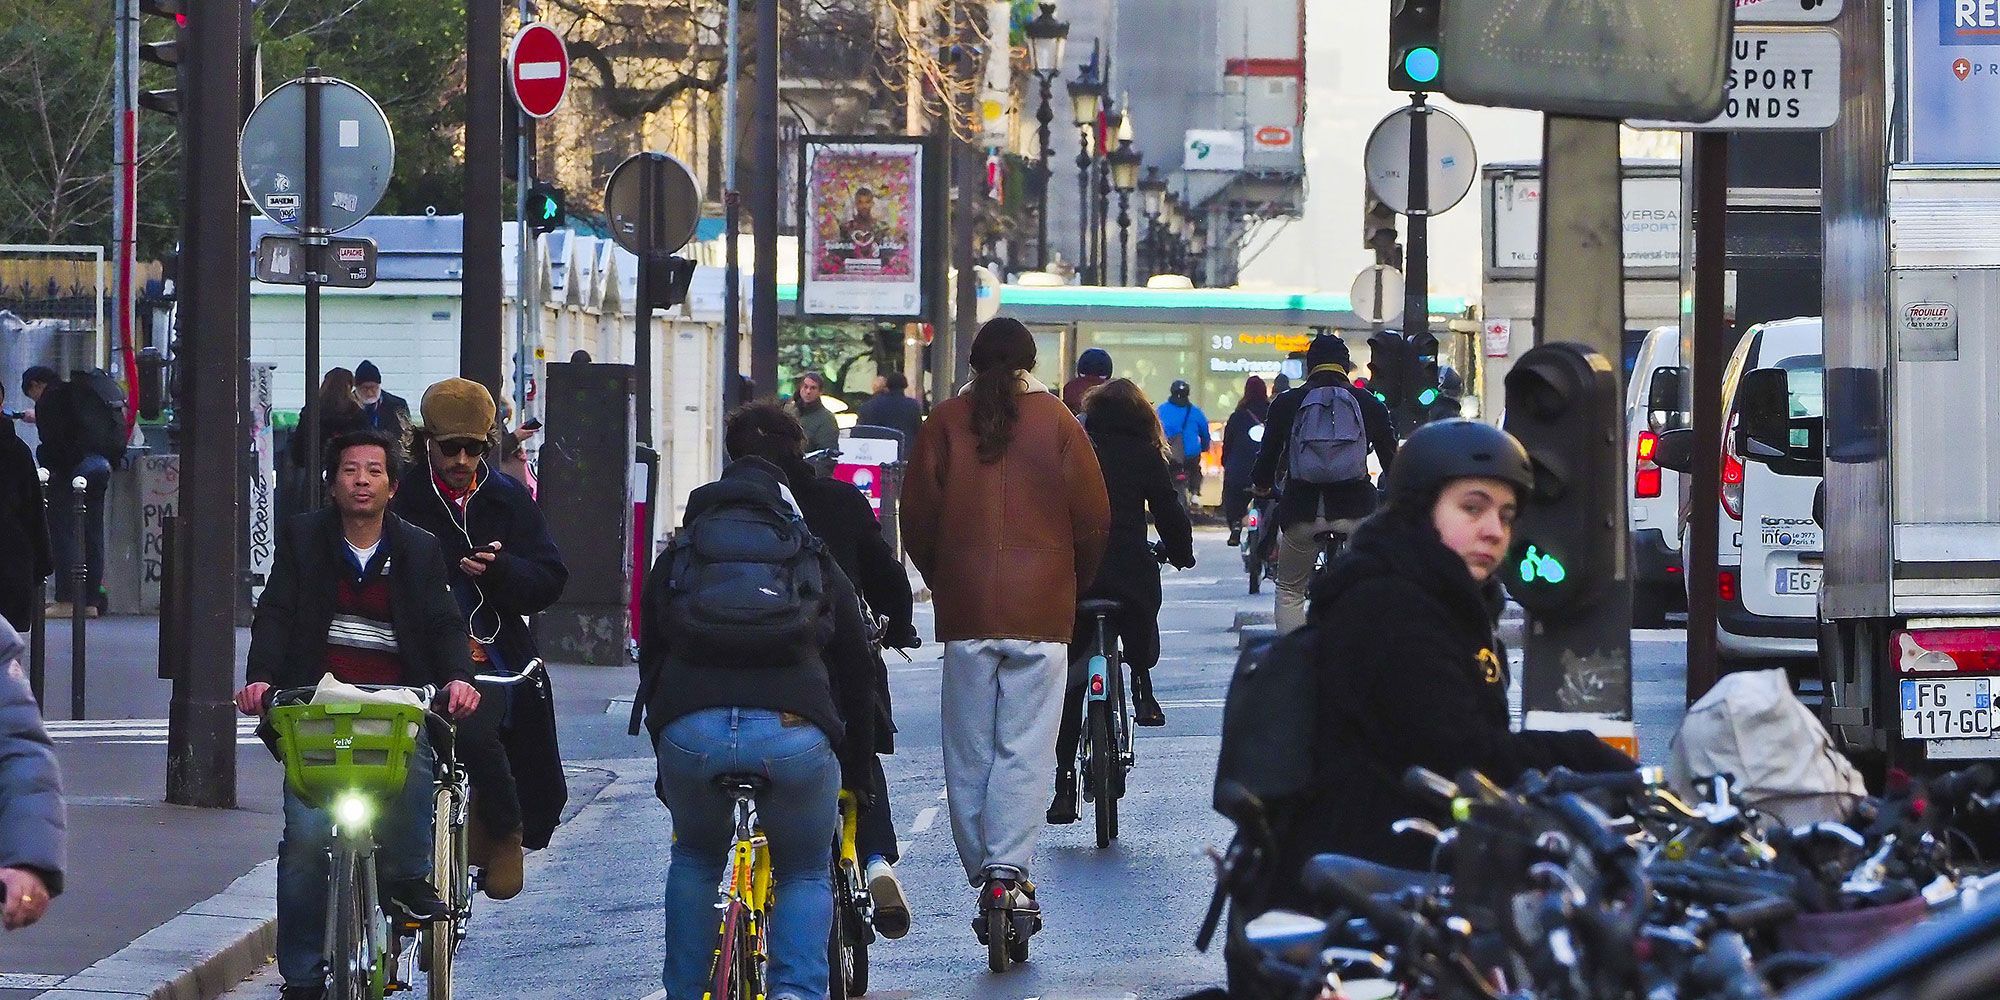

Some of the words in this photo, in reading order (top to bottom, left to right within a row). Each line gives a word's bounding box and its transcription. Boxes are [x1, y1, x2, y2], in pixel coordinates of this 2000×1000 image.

[1955, 0, 2000, 28] RE
[1735, 40, 1768, 60] UF
[1725, 98, 1800, 118] ONDS
[1910, 308, 1949, 317] TROUILLET
[1789, 572, 1823, 591] EG-
[1918, 683, 1947, 707] FG
[1976, 695, 1989, 707] 45
[1913, 709, 1988, 735] 117-GC
